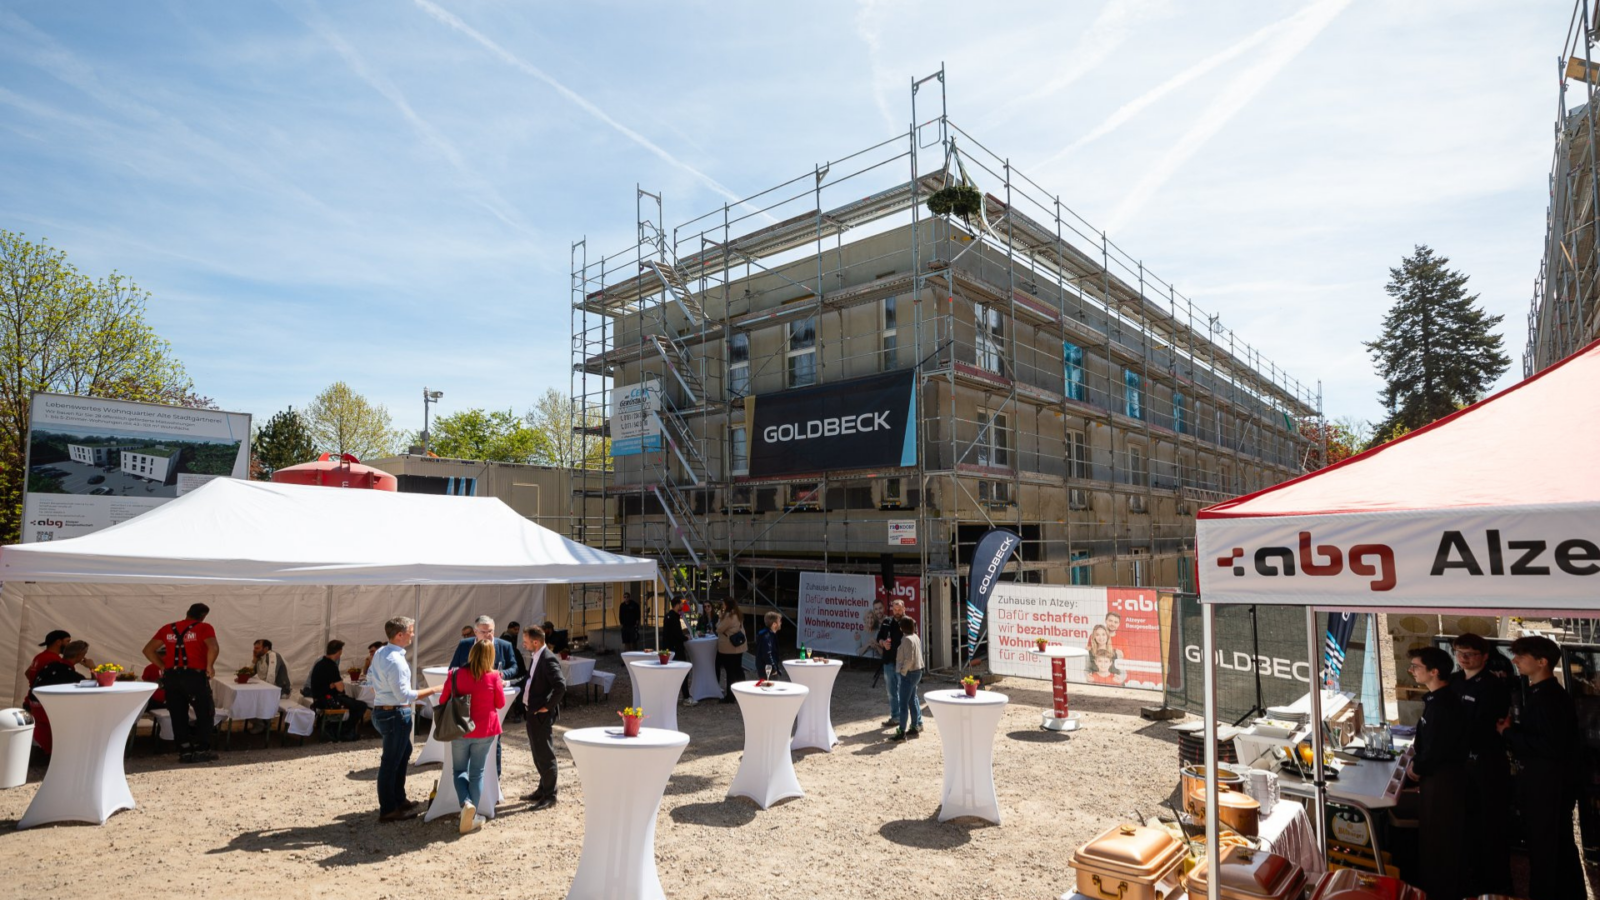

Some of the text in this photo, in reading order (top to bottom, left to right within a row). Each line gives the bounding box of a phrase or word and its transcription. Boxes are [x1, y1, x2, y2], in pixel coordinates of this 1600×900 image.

[45, 401, 101, 412] Lebenswertes
[103, 407, 155, 417] Wohnquartier
[173, 414, 222, 423] Stadtgärtnerei
[763, 410, 891, 443] GOLDBECK
[37, 518, 63, 528] abg
[979, 537, 1013, 595] GOLDBECK
[1254, 529, 1600, 591] abg Alze
[805, 583, 829, 592] Zuhause
[838, 585, 857, 595] Alzey:
[805, 594, 869, 608] Dafür entwickeln
[998, 595, 1078, 609] Zuhause in Alzey:
[1124, 594, 1158, 612] ab
[805, 607, 860, 618] wir innovative
[998, 609, 1089, 624] Dafür schaffen
[804, 616, 865, 631] Wohnkonzepte
[998, 623, 1088, 638] wir bezahlbaren
[804, 628, 832, 640] für alle.
[999, 649, 1041, 663] für alle.
[1185, 645, 1324, 683] GLDBEC
